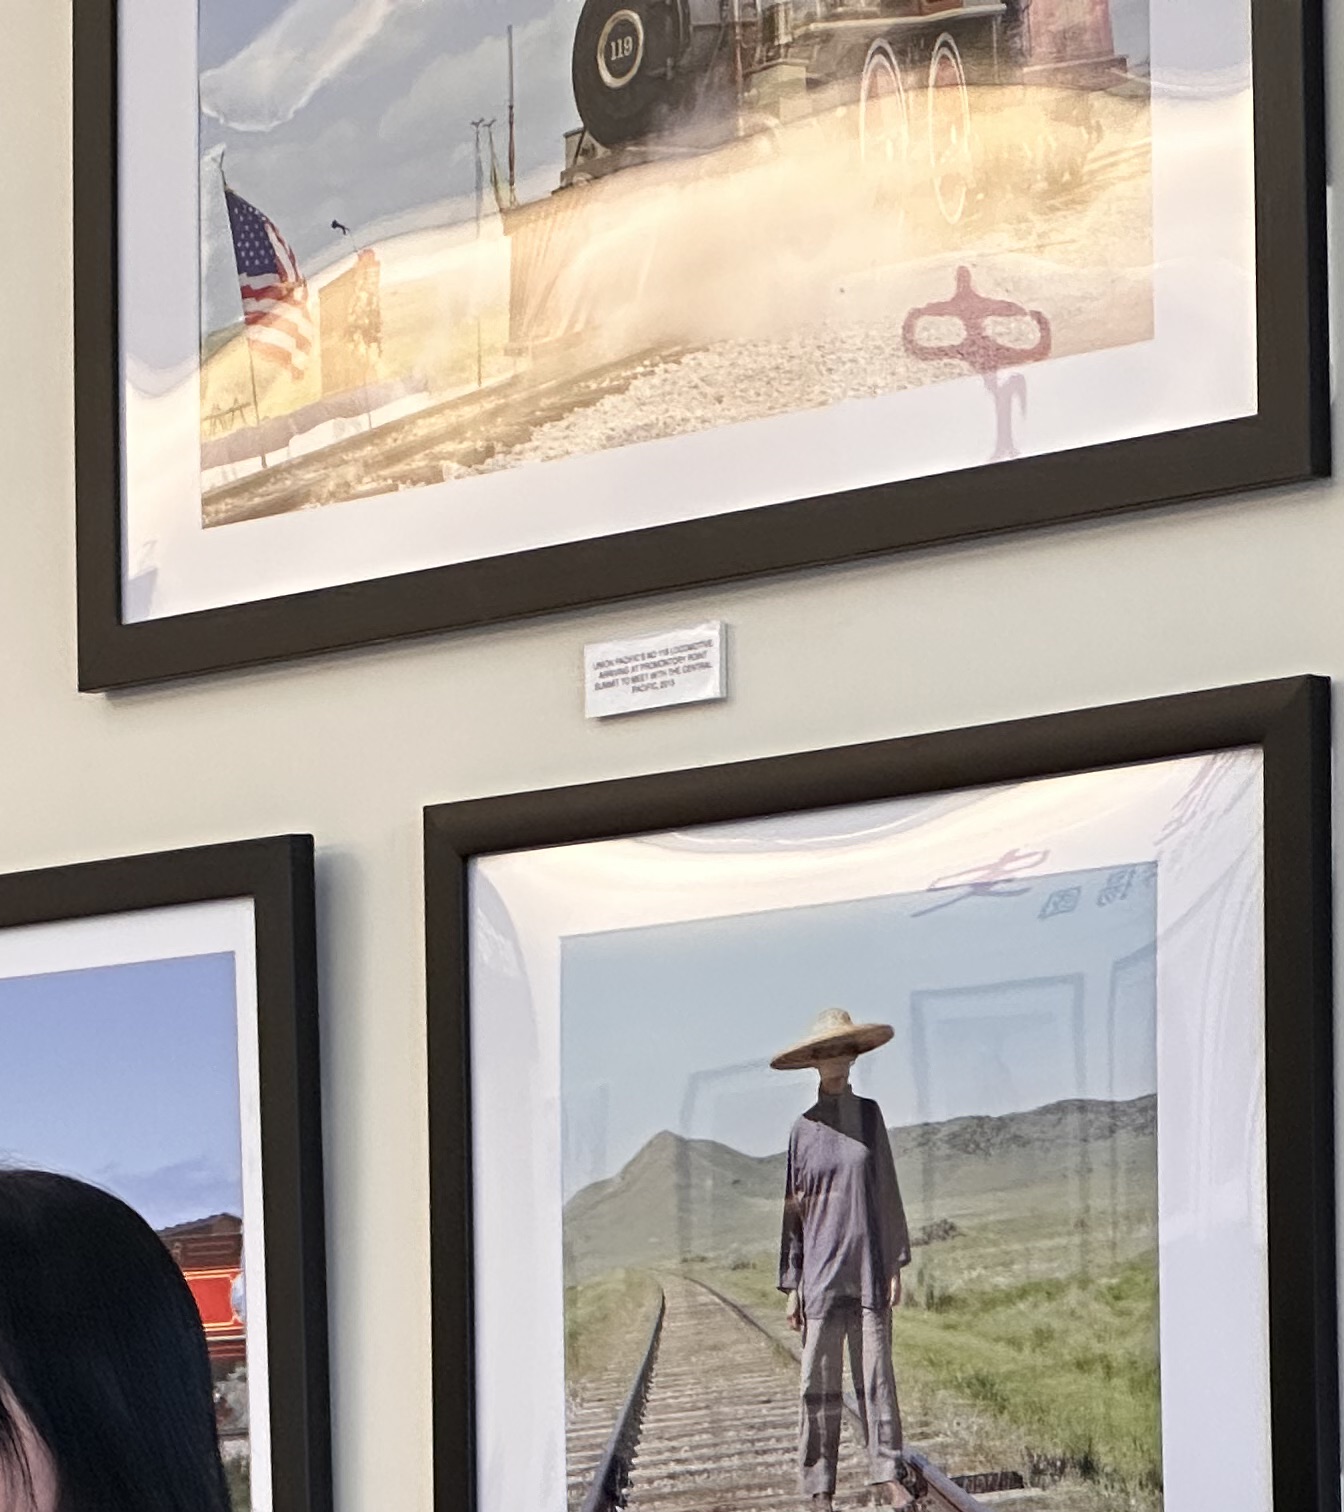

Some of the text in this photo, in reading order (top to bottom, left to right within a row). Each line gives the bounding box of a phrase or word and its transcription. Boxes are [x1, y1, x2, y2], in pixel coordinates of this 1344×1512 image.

[611, 36, 633, 60] 119
[688, 651, 708, 661] POINT
[621, 677, 630, 685] TO
[669, 667, 681, 676] THE
[683, 662, 712, 673] CENTRAL
